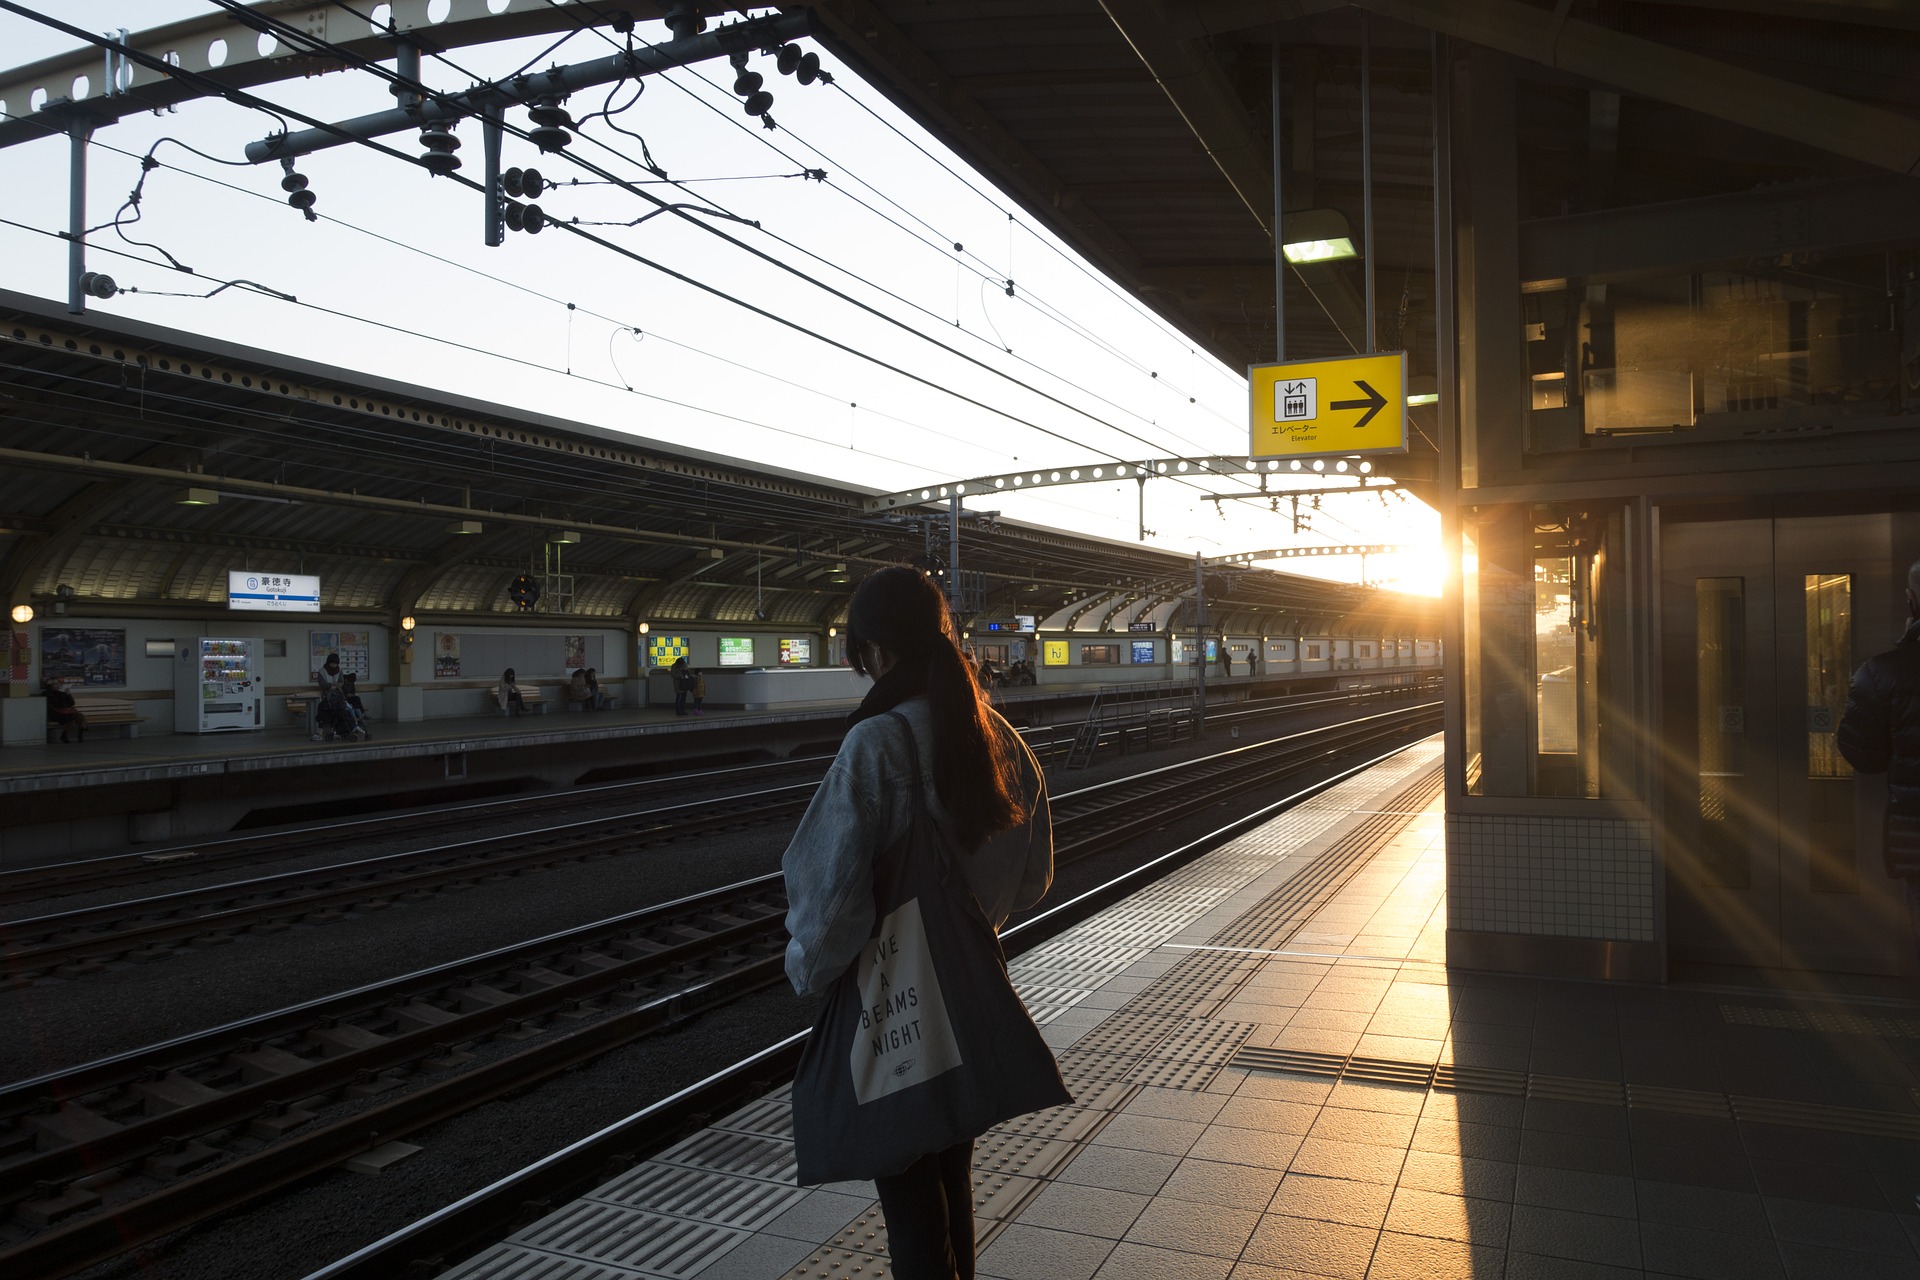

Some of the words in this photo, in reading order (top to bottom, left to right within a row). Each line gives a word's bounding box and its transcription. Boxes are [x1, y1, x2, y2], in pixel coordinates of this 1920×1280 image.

[1271, 424, 1317, 435] エレベーター
[261, 576, 291, 588] 豪徳寺
[265, 586, 287, 594] Gotokuji
[872, 934, 899, 965] VE
[880, 971, 890, 991] A
[861, 987, 919, 1030] BEAMS
[871, 1019, 921, 1058] NIGHT
